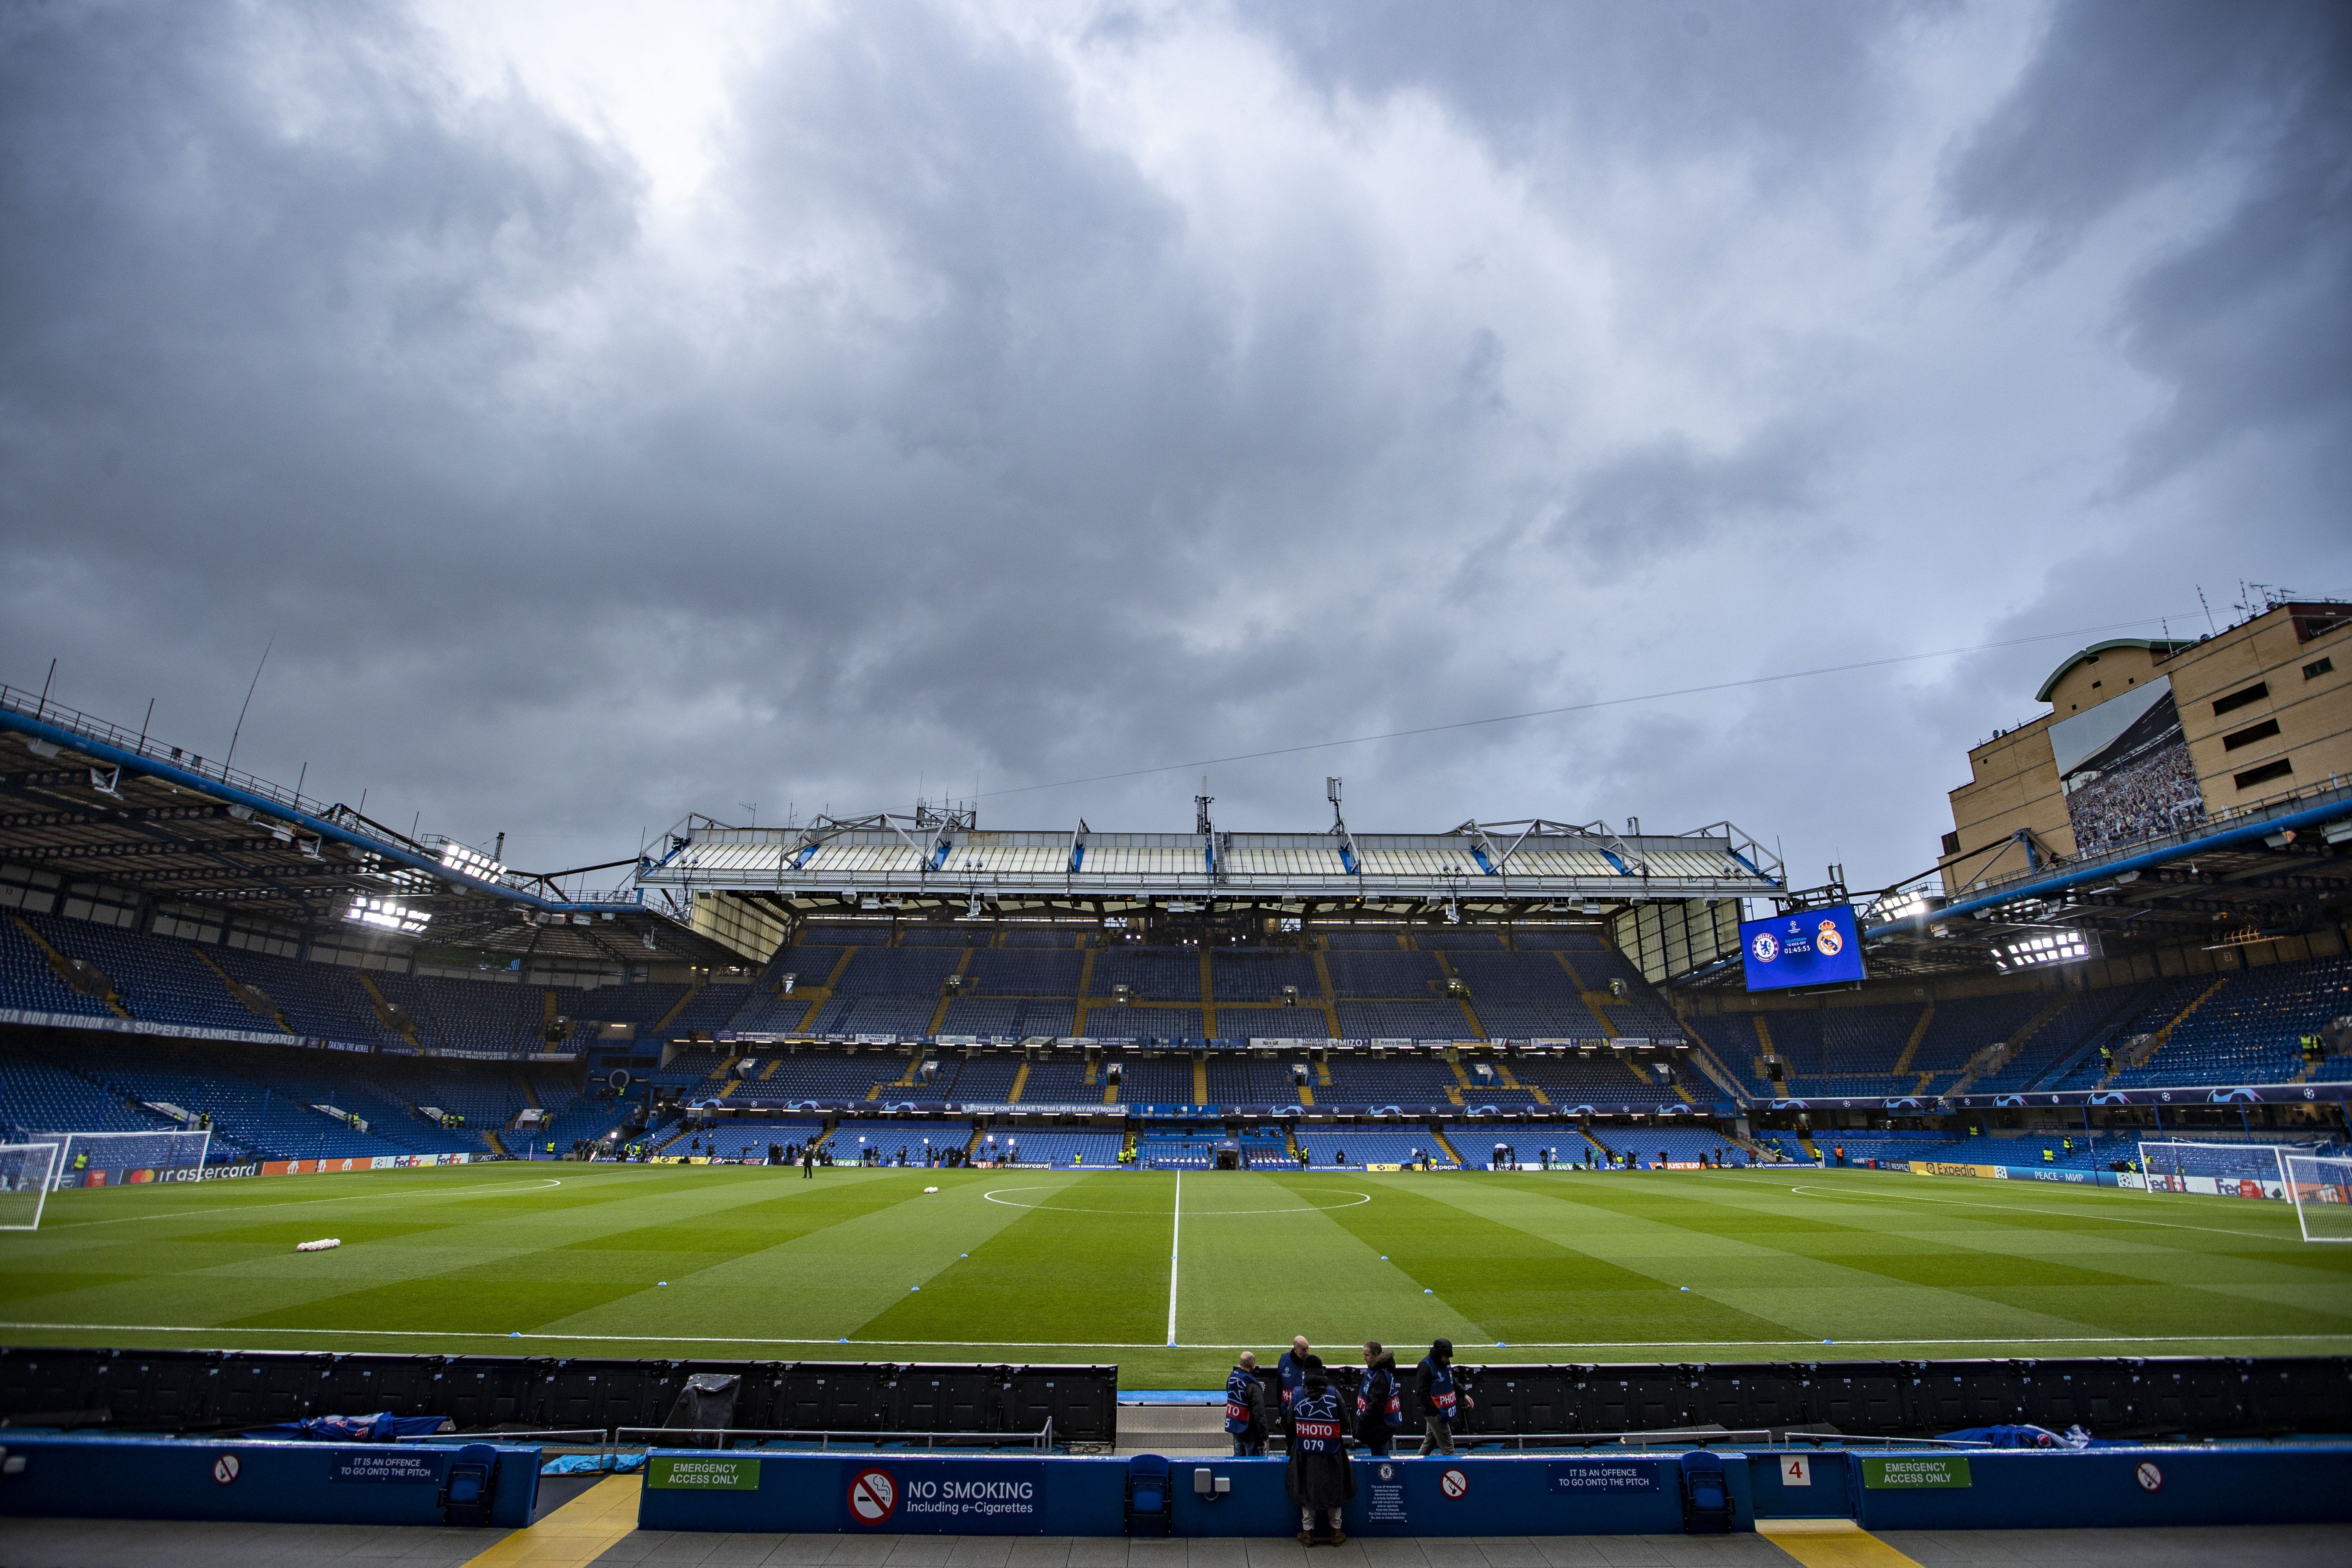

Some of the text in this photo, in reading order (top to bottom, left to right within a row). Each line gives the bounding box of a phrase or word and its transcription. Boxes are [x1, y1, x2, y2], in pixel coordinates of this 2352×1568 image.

[1784, 945, 1810, 954] 01:45:53
[23, 1011, 104, 1029] OUR RELIGION
[134, 1022, 296, 1045] SUPER FRANKIE LAMPARD
[328, 1041, 369, 1053] TAKING THE MIKEL
[394, 1155, 422, 1167] FedEx
[436, 1154, 462, 1165] FedEx
[1937, 1163, 1976, 1177] Expedia
[2034, 1171, 2084, 1182] PEACE МИР
[1296, 1423, 1332, 1436] PHOTO
[1303, 1439, 1324, 1451] 079
[363, 1458, 371, 1466] IS
[386, 1458, 421, 1467] OFFENCE
[673, 1463, 737, 1473] EMERGENCY
[1885, 1462, 1947, 1472] EMERGENCY
[341, 1467, 351, 1475] TO
[367, 1467, 389, 1476] ONTO
[391, 1468, 406, 1476] THE
[407, 1468, 431, 1476] PITCH
[1569, 1469, 1577, 1477] IT
[1579, 1469, 1587, 1477] IS
[1601, 1469, 1637, 1477] OFFENCE
[1788, 1461, 1803, 1479] 4
[668, 1474, 739, 1484] ACCESS ONLY
[1884, 1473, 1951, 1483] ACCESS ONLY
[908, 1481, 1033, 1499] NO SMOKING
[906, 1501, 1033, 1516] Including e-Cigarettes
